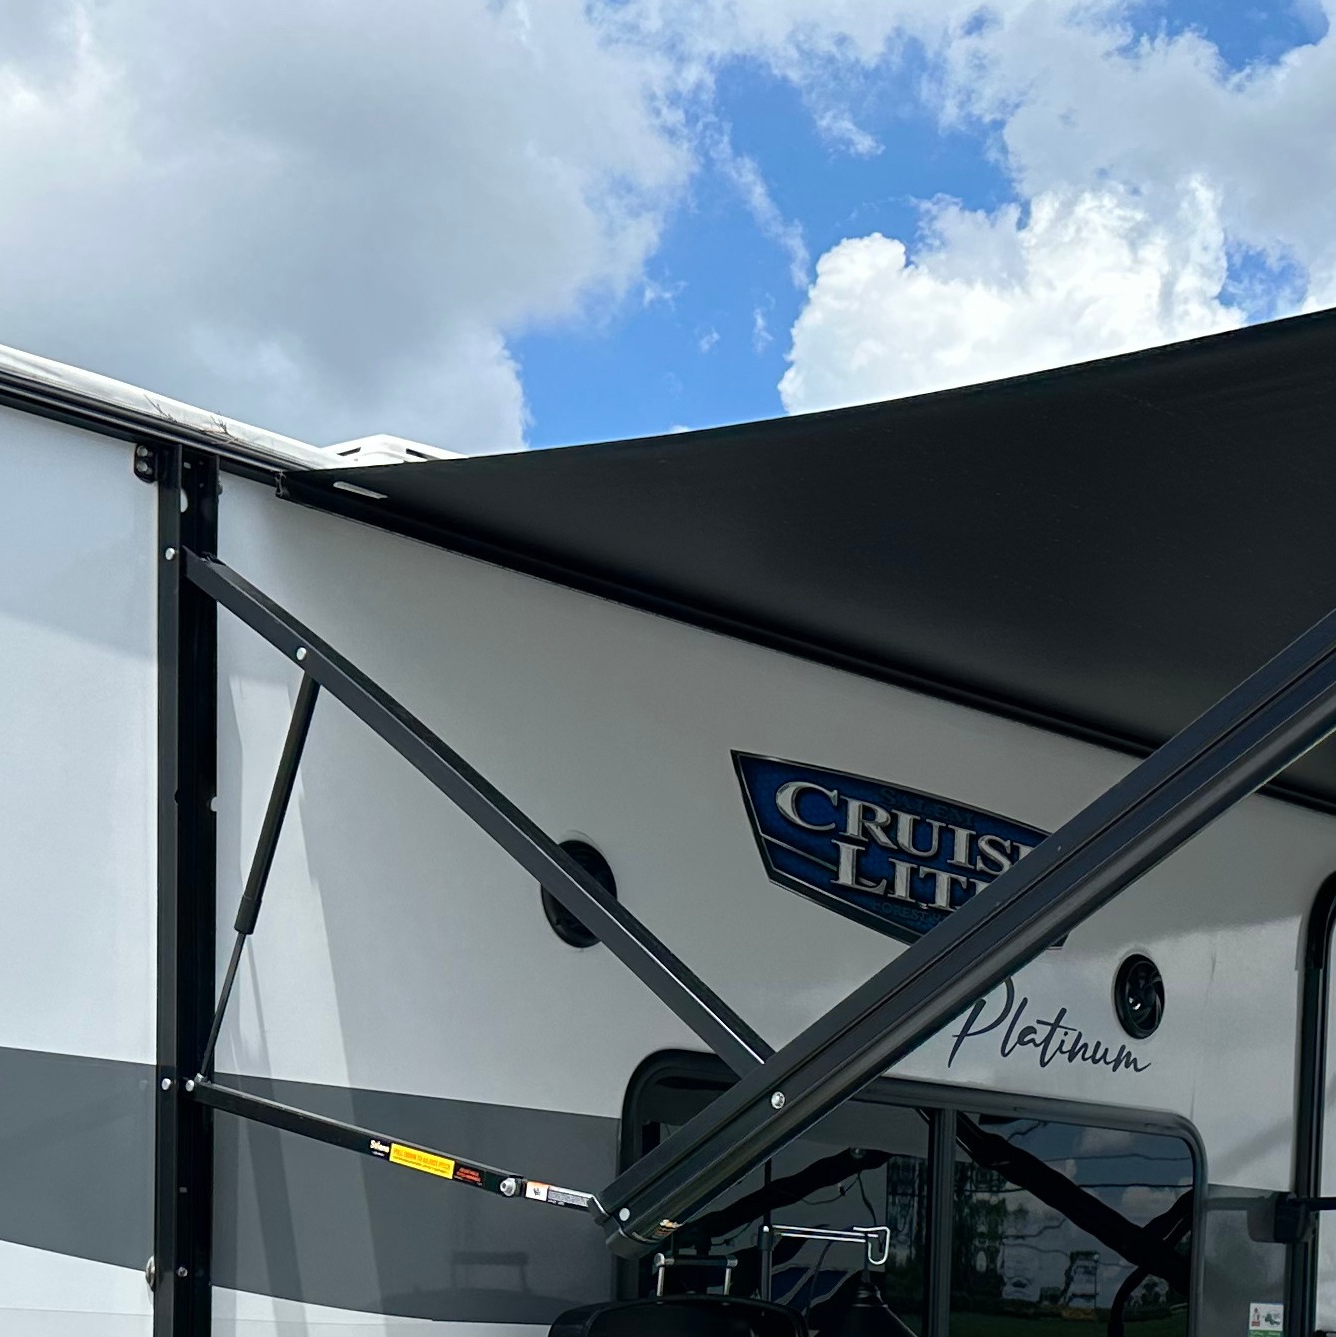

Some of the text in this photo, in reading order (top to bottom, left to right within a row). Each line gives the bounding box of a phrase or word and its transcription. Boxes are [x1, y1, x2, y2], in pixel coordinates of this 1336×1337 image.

[775, 780, 1035, 876] CRUIS
[830, 838, 990, 912] LIT
[947, 975, 1152, 1073] Platinum
